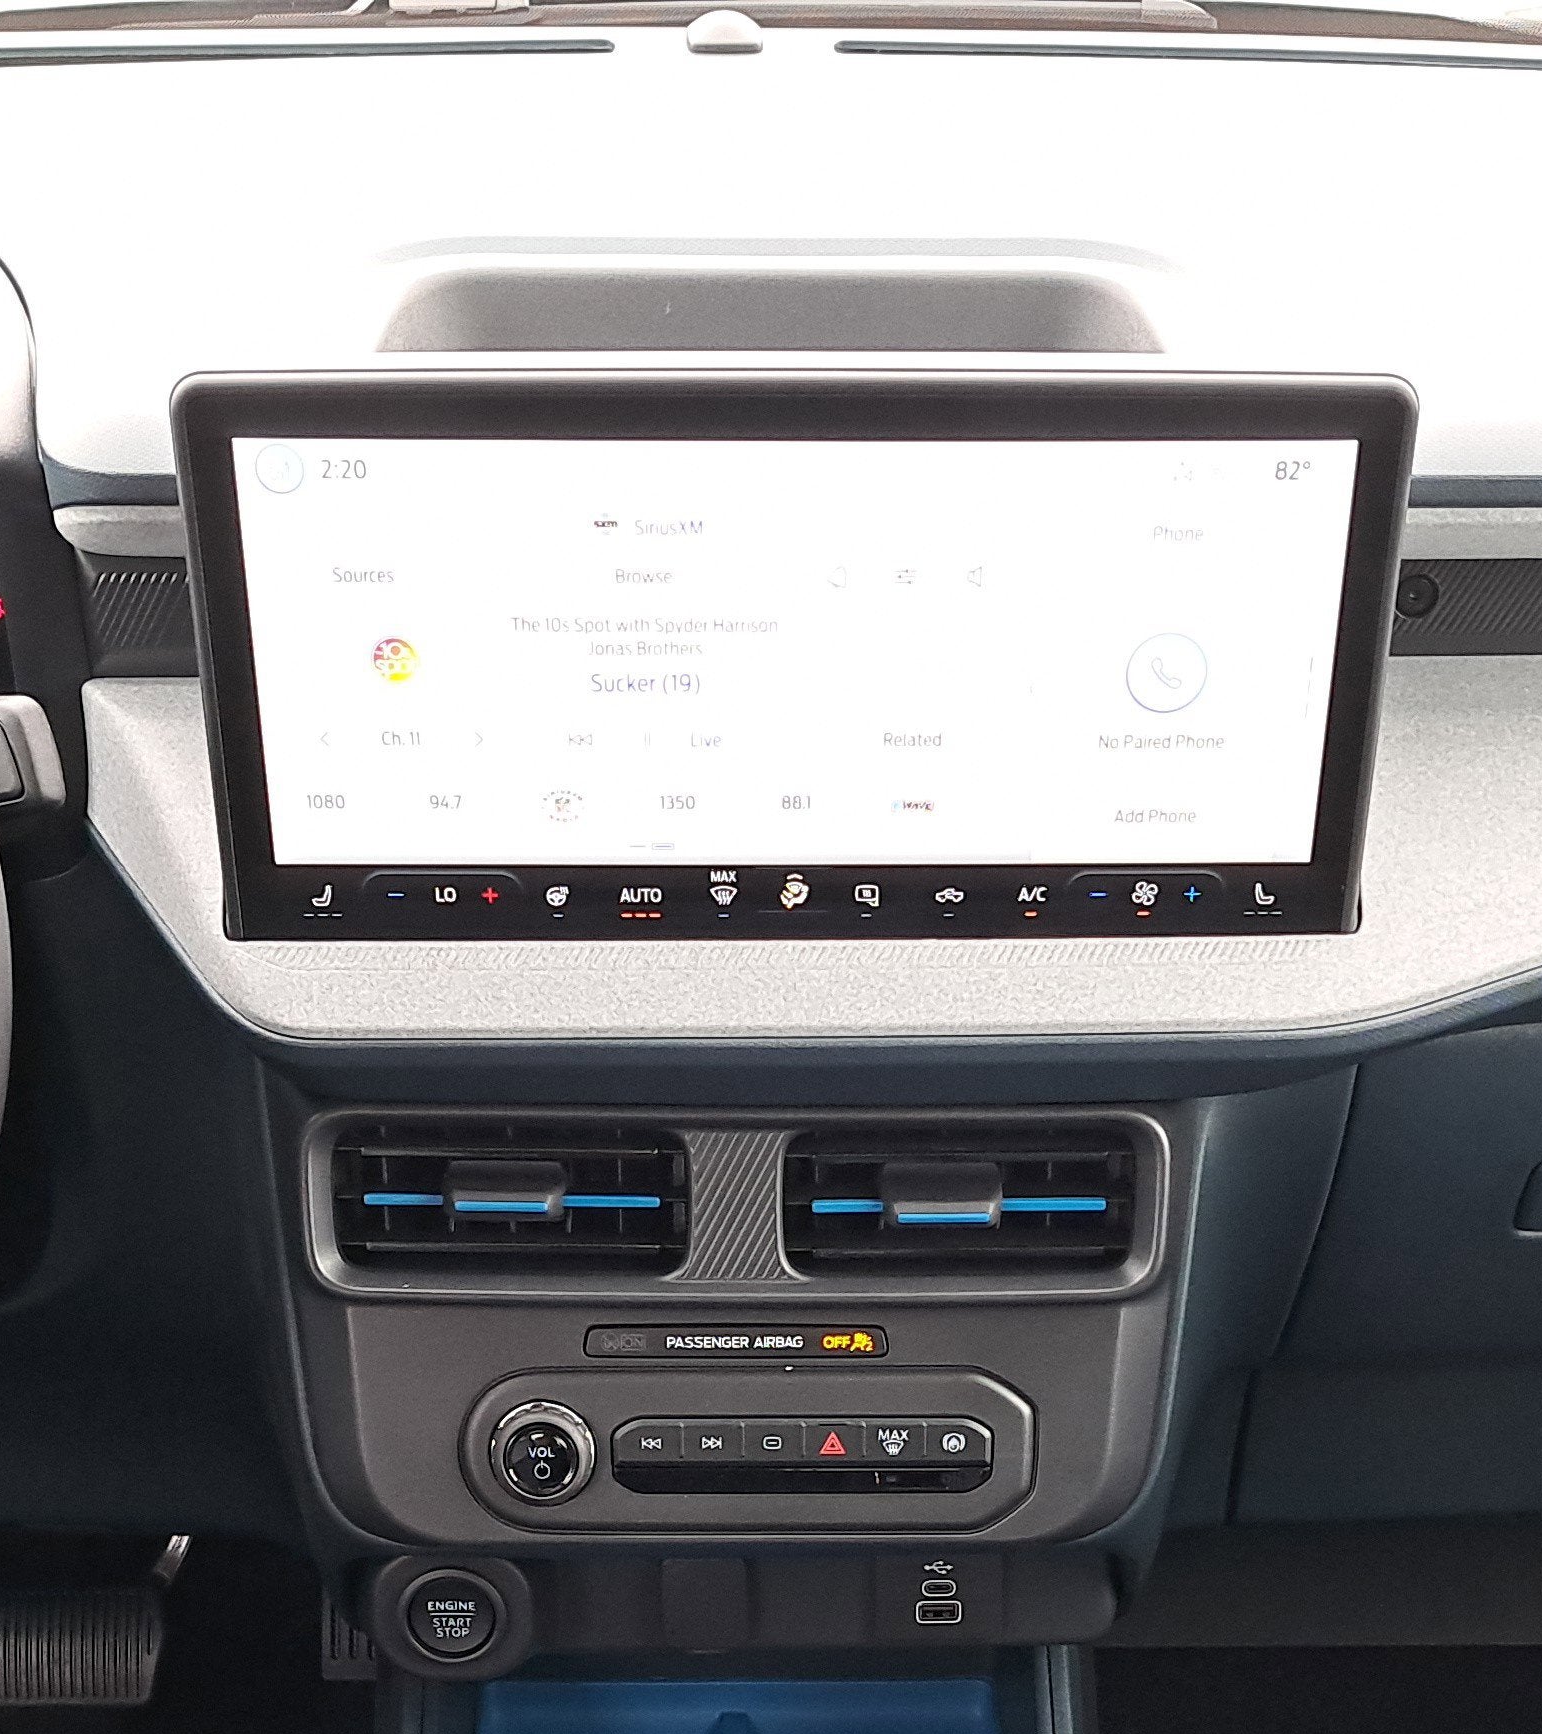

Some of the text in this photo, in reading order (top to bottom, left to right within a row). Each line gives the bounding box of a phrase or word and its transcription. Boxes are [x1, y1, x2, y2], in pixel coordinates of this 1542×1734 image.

[321, 460, 366, 479] 2:20
[1275, 461, 1311, 481] 82°
[635, 521, 703, 536] SiriusXM
[1153, 526, 1204, 542] Phone
[332, 568, 394, 583] Sources
[616, 569, 672, 584] Browse
[510, 617, 540, 632] The
[546, 619, 569, 632] 10s
[575, 617, 610, 636] Spot
[616, 619, 650, 632] with
[714, 619, 778, 633] Harrison
[588, 642, 702, 656] Jonas Brothers
[591, 674, 701, 695] Sucker (19)
[381, 732, 421, 746] Ch. 11
[691, 734, 721, 747] Live
[883, 733, 942, 747] Related
[1098, 734, 1224, 750] No Paired Phone
[307, 795, 345, 809] 1080
[429, 795, 461, 809] 94.7
[659, 796, 696, 810] 1350
[781, 796, 811, 810] 88.1
[1114, 809, 1196, 824] Add Phone
[710, 870, 737, 883] MAX
[434, 887, 457, 903] LO
[620, 887, 662, 904] AUTO
[1017, 886, 1047, 902] A/C
[666, 1336, 804, 1349] PASSENGER AIRBAG
[822, 1336, 851, 1350] OFF
[878, 1428, 909, 1441] MAX
[527, 1446, 556, 1459] VOL
[427, 1601, 476, 1611] ENGINE
[432, 1617, 472, 1628] START
[436, 1627, 470, 1638] STOP
